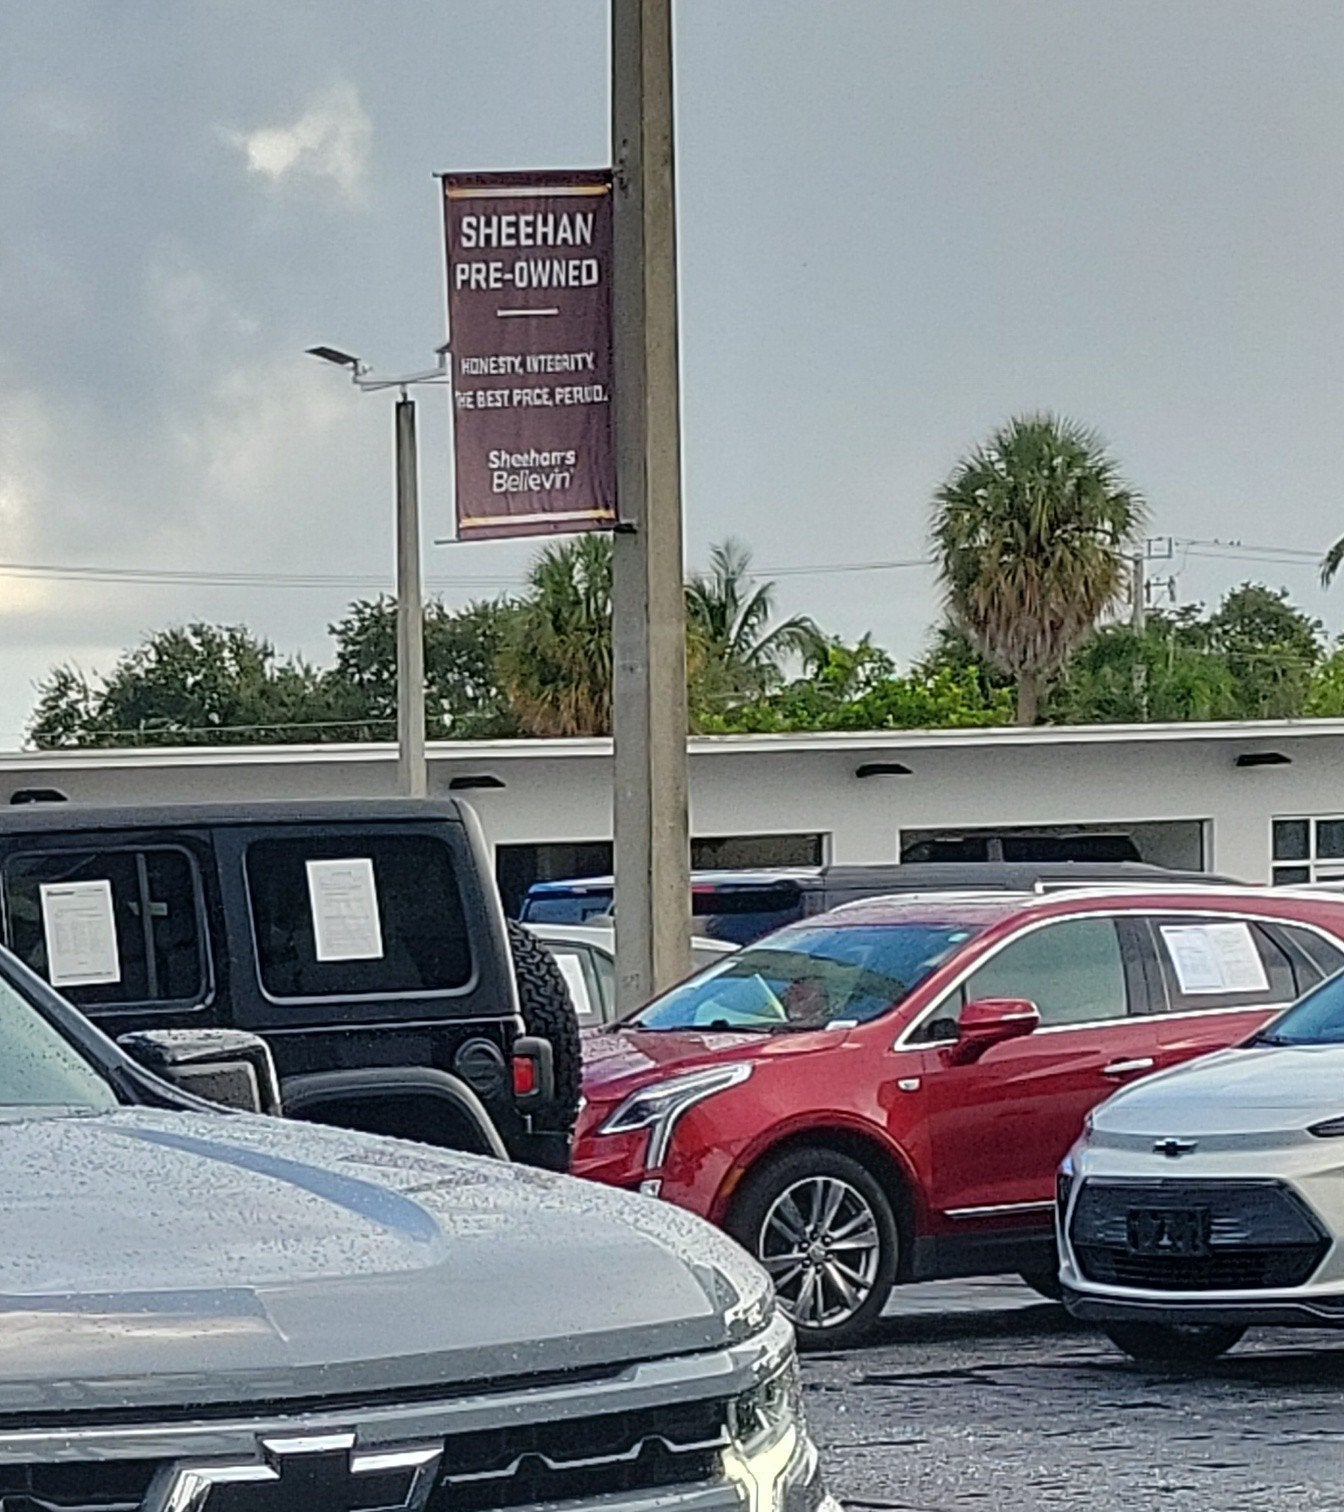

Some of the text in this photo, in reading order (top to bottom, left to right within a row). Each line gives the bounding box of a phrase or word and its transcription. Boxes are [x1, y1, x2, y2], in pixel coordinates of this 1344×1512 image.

[461, 212, 594, 249] SHEEHAN
[455, 258, 599, 290] PRE-OWNED
[476, 388, 510, 407] BEST
